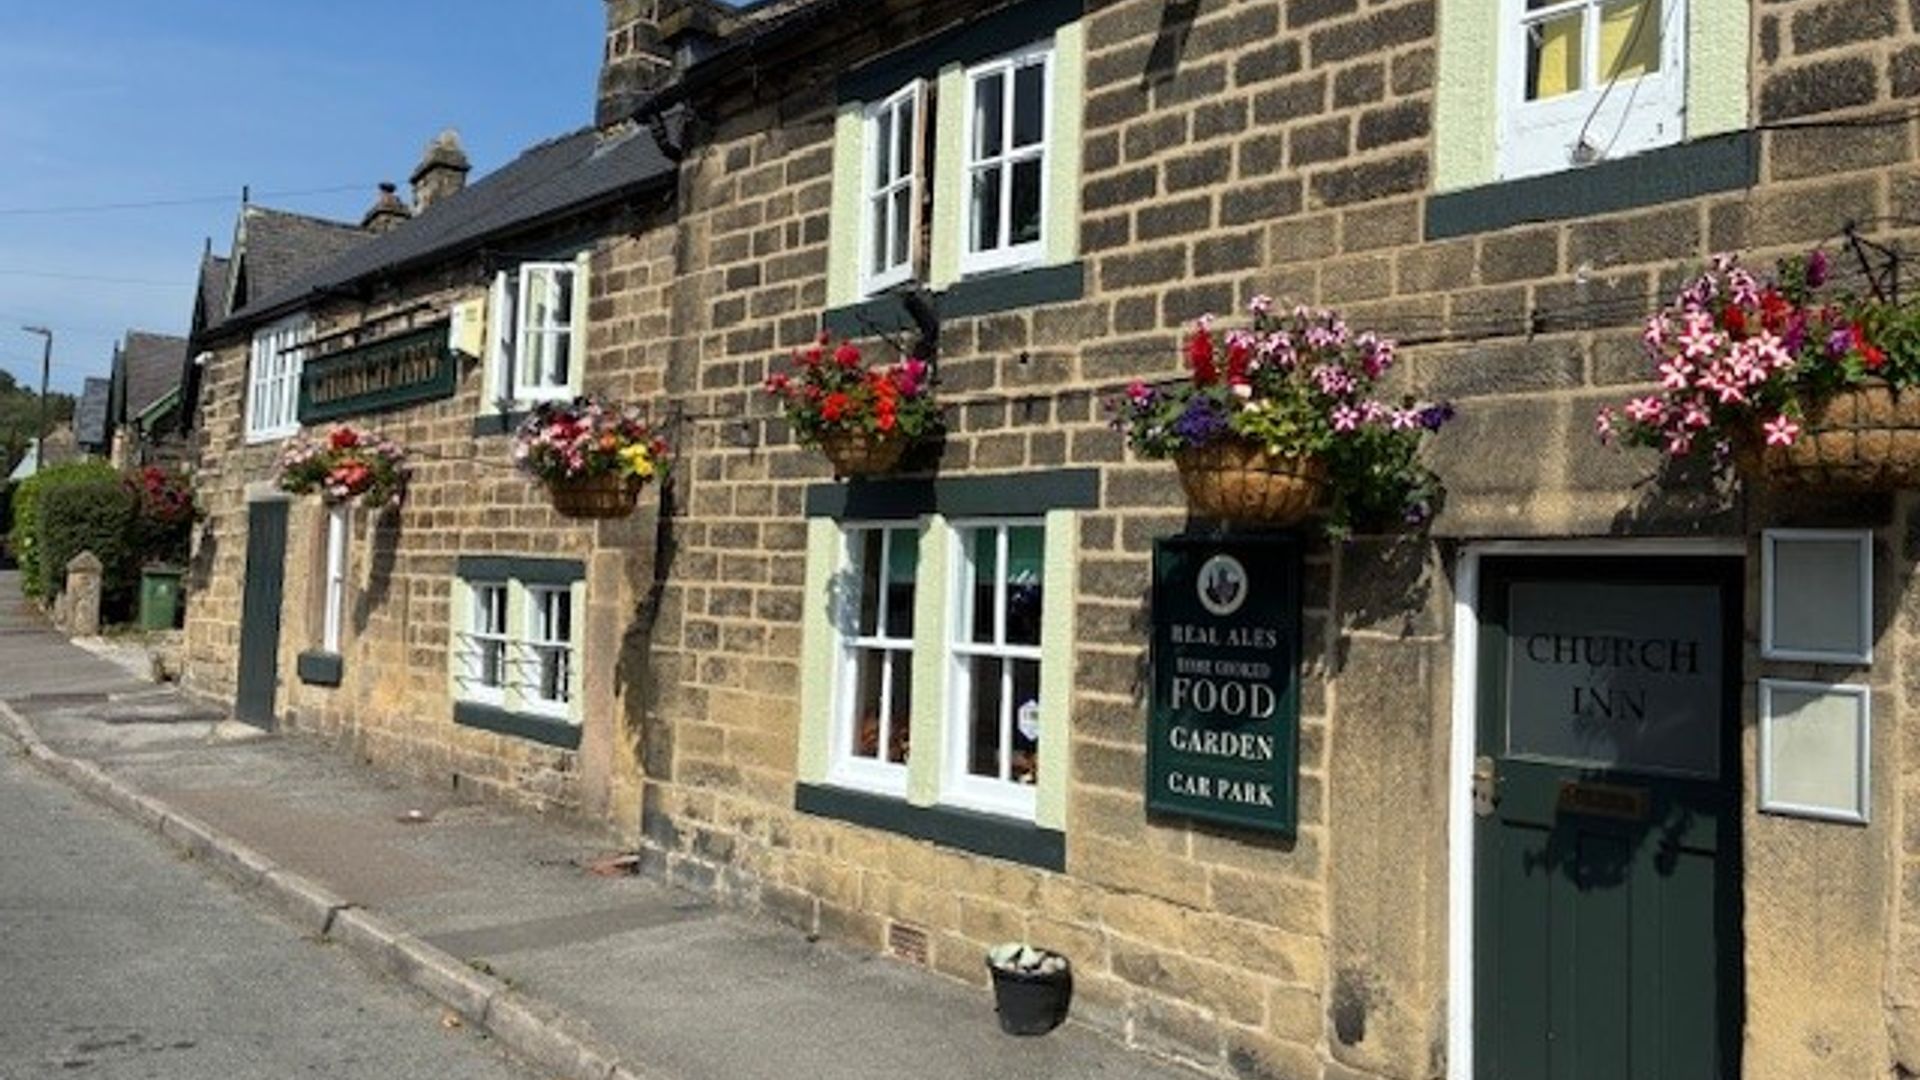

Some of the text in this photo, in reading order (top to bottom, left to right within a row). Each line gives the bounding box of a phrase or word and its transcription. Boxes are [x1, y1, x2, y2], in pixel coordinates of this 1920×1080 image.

[1171, 624, 1277, 649] REAL ALES
[1527, 634, 1701, 673] CHURCH
[1171, 677, 1275, 718] FOOD
[1572, 686, 1647, 720] INN
[1169, 726, 1273, 760] GARDEN
[1168, 771, 1274, 808] CAR PARK
